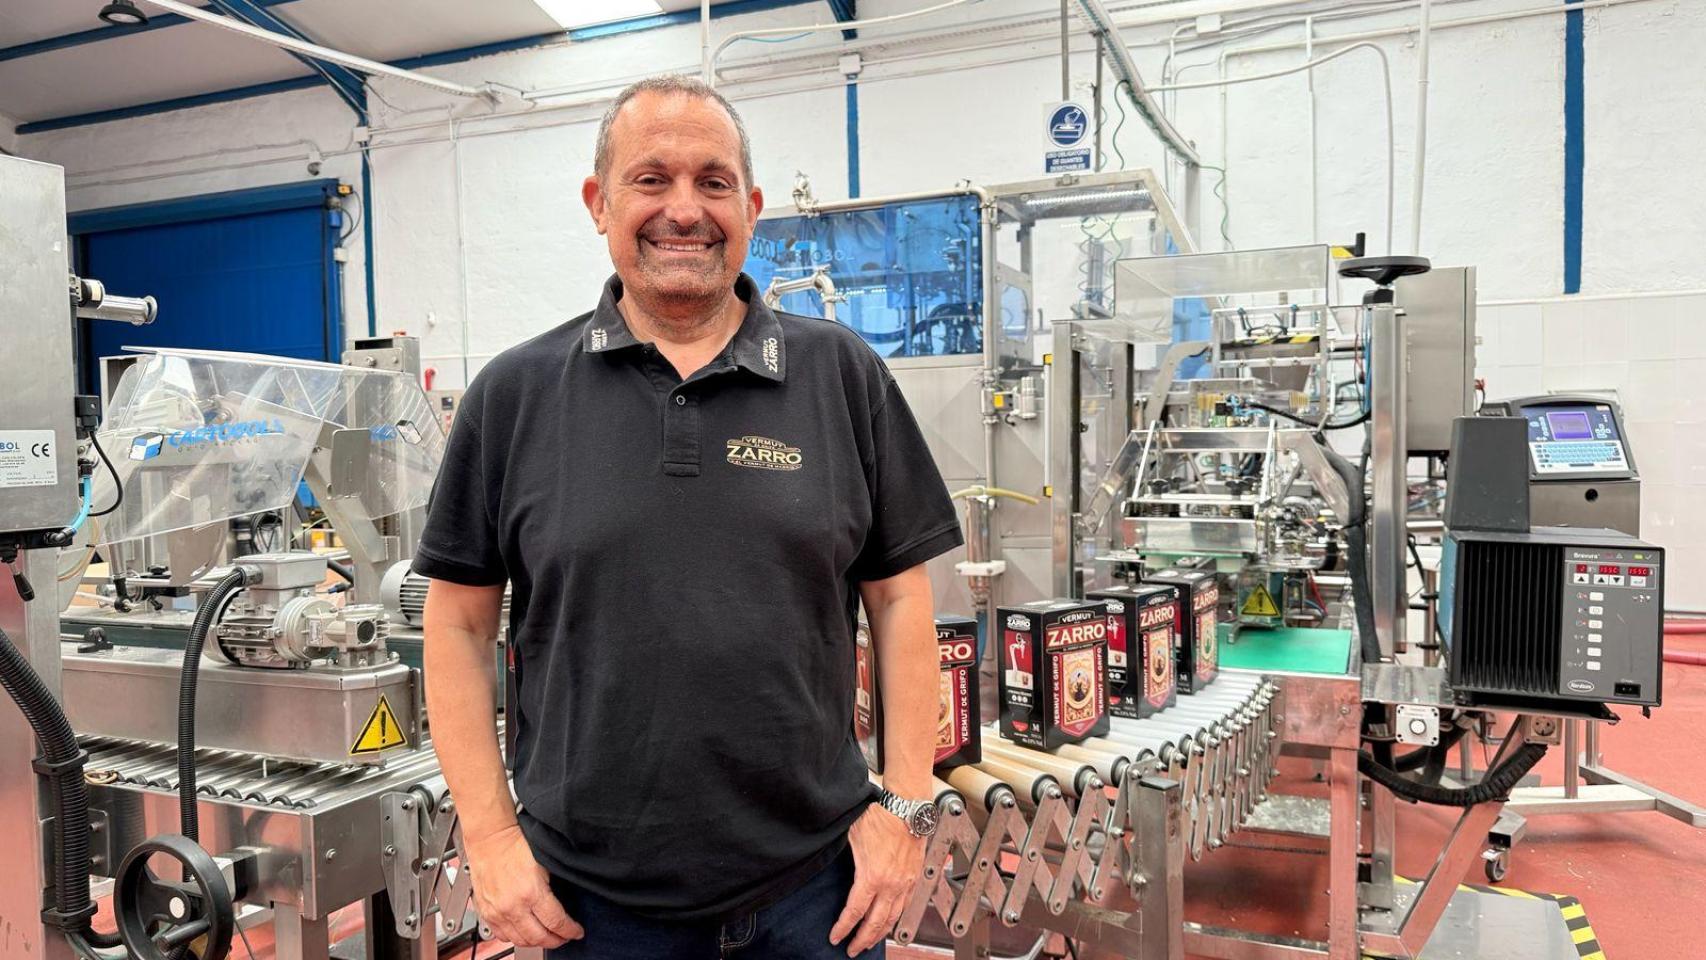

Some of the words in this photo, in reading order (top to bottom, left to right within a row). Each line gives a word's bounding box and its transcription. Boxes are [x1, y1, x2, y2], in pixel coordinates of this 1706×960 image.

[768, 337, 778, 373] ZARRO
[745, 438, 784, 448] VERMUT
[727, 445, 803, 465] ZARRO
[1194, 588, 1219, 610] ZARRO
[1007, 619, 1031, 628] ZARRO
[1062, 612, 1092, 624] VERMUT
[1140, 605, 1175, 627] ZARRO
[1048, 623, 1105, 647] ZARRO
[959, 669, 967, 694] GRIFO
[960, 707, 969, 743] VERMUT
